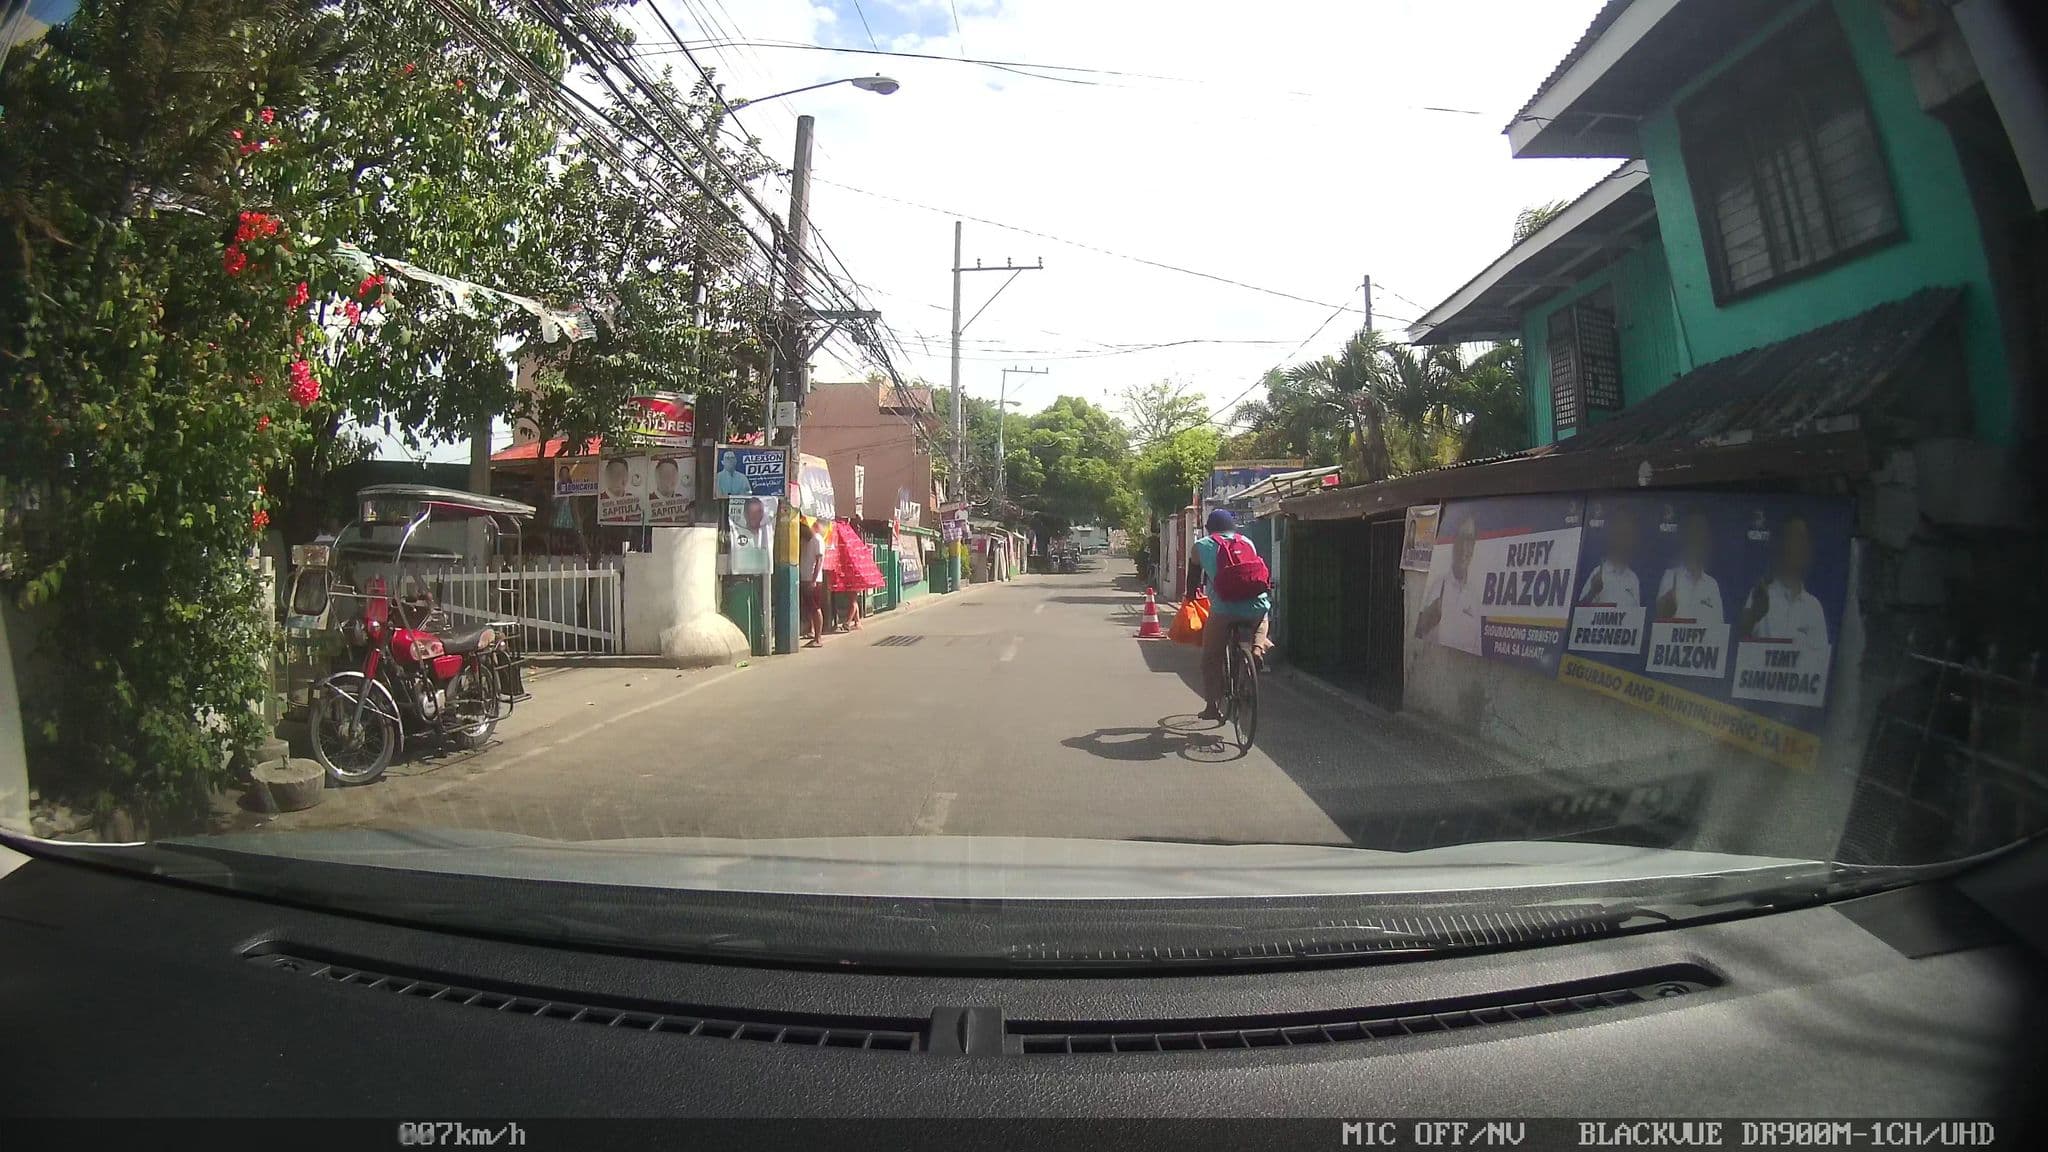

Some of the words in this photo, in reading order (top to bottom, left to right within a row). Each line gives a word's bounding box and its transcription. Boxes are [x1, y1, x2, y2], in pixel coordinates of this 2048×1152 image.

[748, 464, 781, 475] DIAZ
[603, 504, 640, 517] SAPITULA
[651, 505, 690, 517] SAPITULA
[1506, 539, 1555, 567] RUFFY
[1482, 569, 1571, 607] BIAZON
[1591, 612, 1626, 627] JIMMY
[1575, 627, 1638, 646] FRESNEDI
[1672, 627, 1706, 643] RUFFY
[1512, 643, 1520, 656] SA
[1653, 645, 1719, 670] BIAZON
[1765, 650, 1800, 668] TEMY
[1565, 662, 1623, 689] SIGURADO
[1625, 682, 1655, 704] ANG
[1739, 670, 1821, 694] SIMUNDAC
